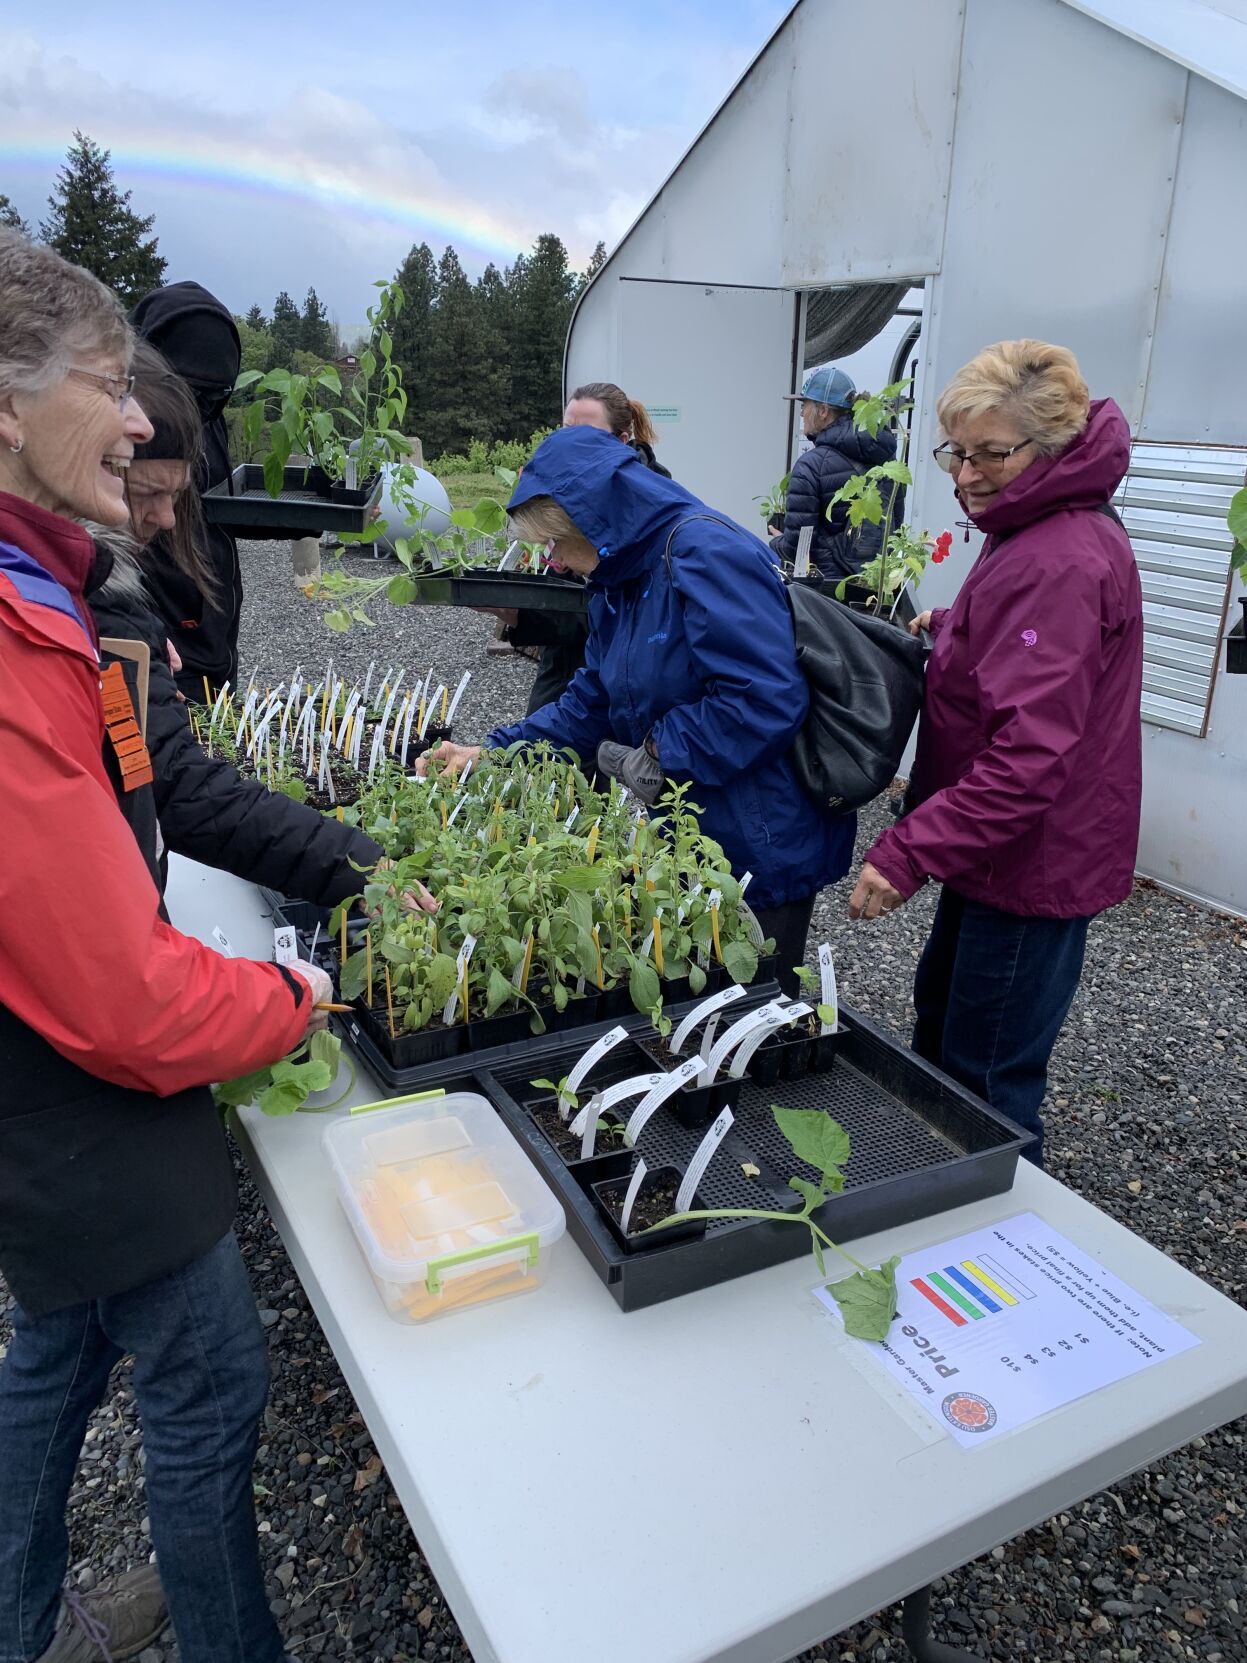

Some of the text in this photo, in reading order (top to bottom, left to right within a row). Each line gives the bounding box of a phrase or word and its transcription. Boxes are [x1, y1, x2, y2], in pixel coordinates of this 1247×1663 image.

[992, 1231, 1007, 1242] the
[1005, 1240, 1015, 1248] in
[1014, 1247, 1041, 1268] stakes
[1045, 1261, 1066, 1276] final
[1066, 1261, 1093, 1283] Yellow
[1039, 1268, 1063, 1285] price
[1060, 1285, 1077, 1298] two
[1071, 1281, 1085, 1291] for
[1084, 1290, 1097, 1300] up
[1101, 1288, 1122, 1304] Blue
[1077, 1298, 1093, 1310] are
[1096, 1300, 1119, 1318] them
[1092, 1310, 1116, 1329] there
[1117, 1318, 1137, 1332] add
[1057, 1339, 1074, 1351] $2
[1073, 1332, 1090, 1344] $1
[1138, 1331, 1166, 1353] plant,
[901, 1325, 960, 1378] Price
[1040, 1346, 1057, 1358] $3
[1127, 1337, 1153, 1359] Note:
[1000, 1356, 1022, 1373] $10
[1023, 1353, 1039, 1365] $4
[904, 1366, 935, 1395] Master
